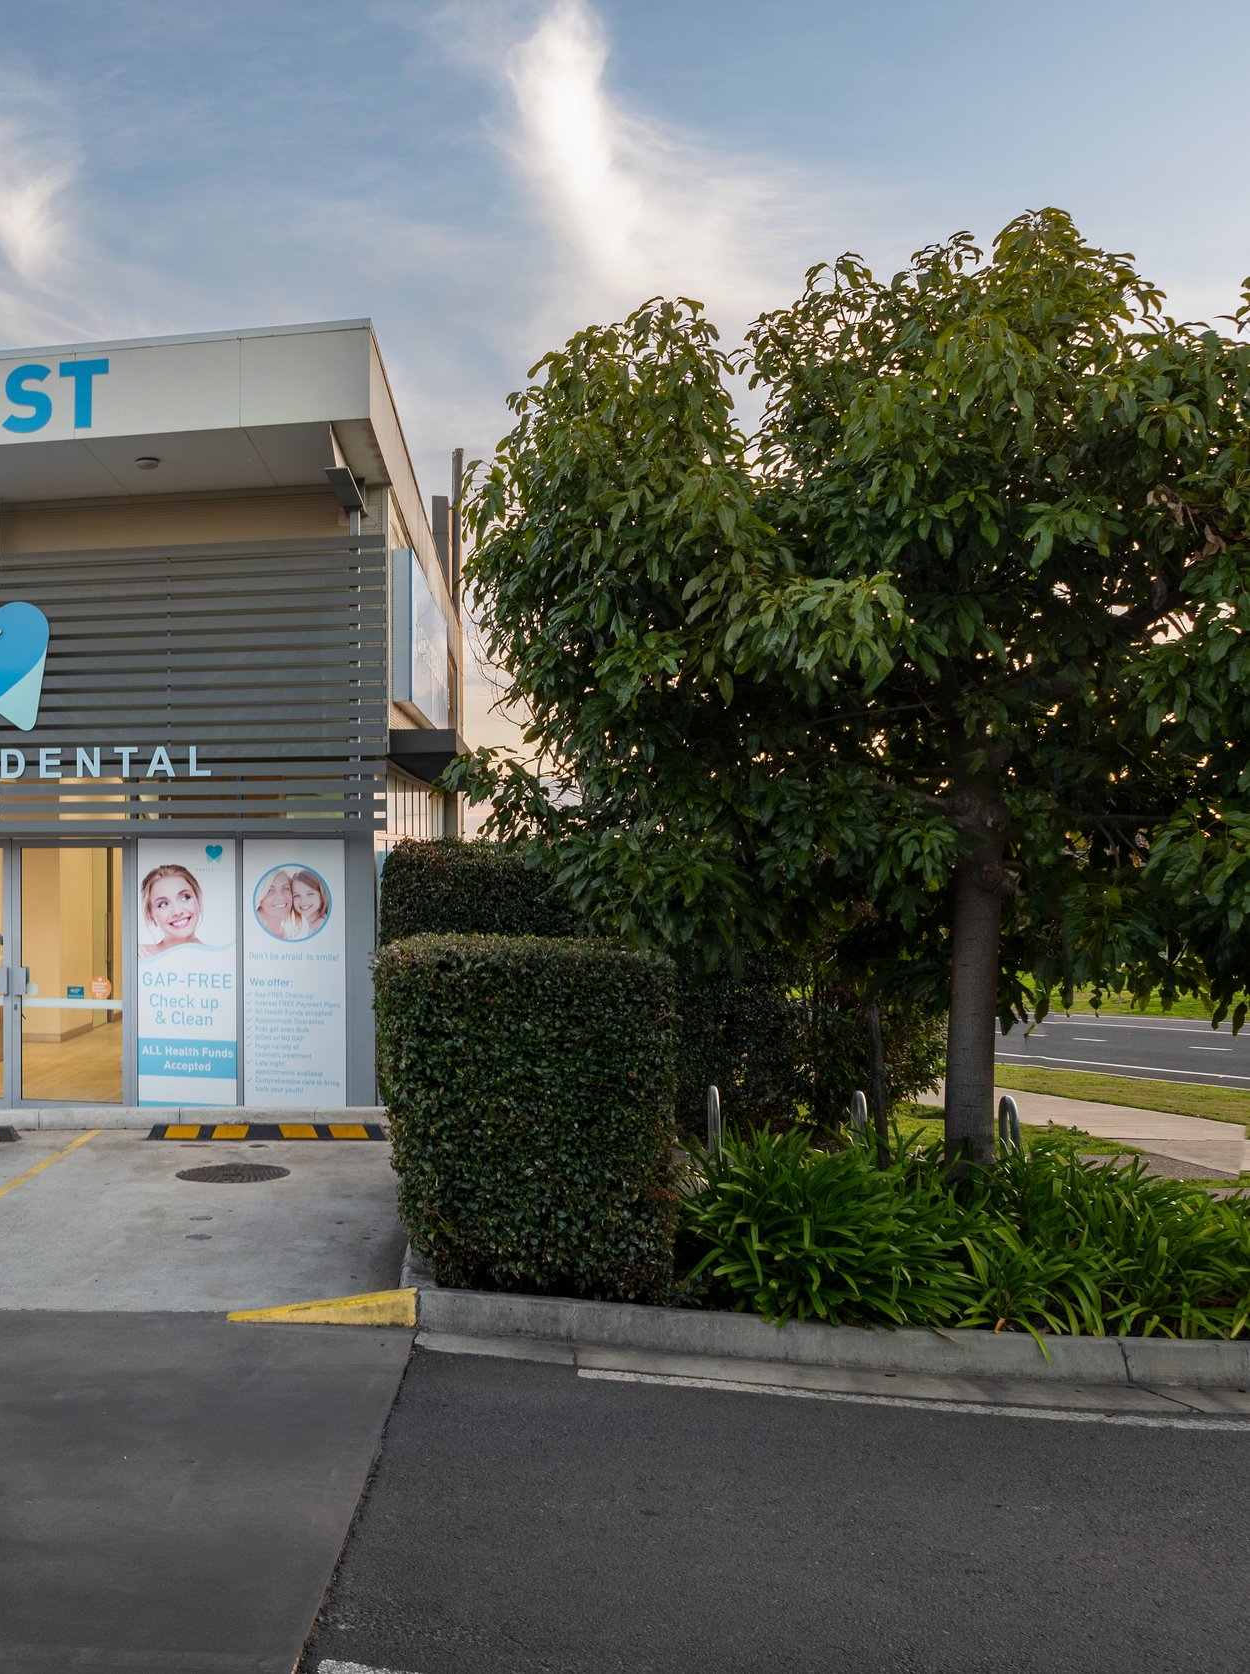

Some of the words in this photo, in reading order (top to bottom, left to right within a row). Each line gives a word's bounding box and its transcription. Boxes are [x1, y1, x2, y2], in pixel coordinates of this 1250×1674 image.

[0, 745, 212, 780] DENTAL
[270, 952, 278, 960] be
[280, 952, 302, 960] afraid
[142, 972, 232, 989] GAP-FREE
[250, 978, 264, 986] We
[268, 978, 293, 987] offer:
[150, 993, 194, 1008] Check
[201, 998, 218, 1013] up
[156, 1010, 166, 1025] &
[172, 1011, 213, 1026] Clean
[142, 1045, 162, 1056] ALL
[165, 1046, 198, 1056] Health
[202, 1048, 234, 1058] Funds
[164, 1060, 211, 1072] Accepted
